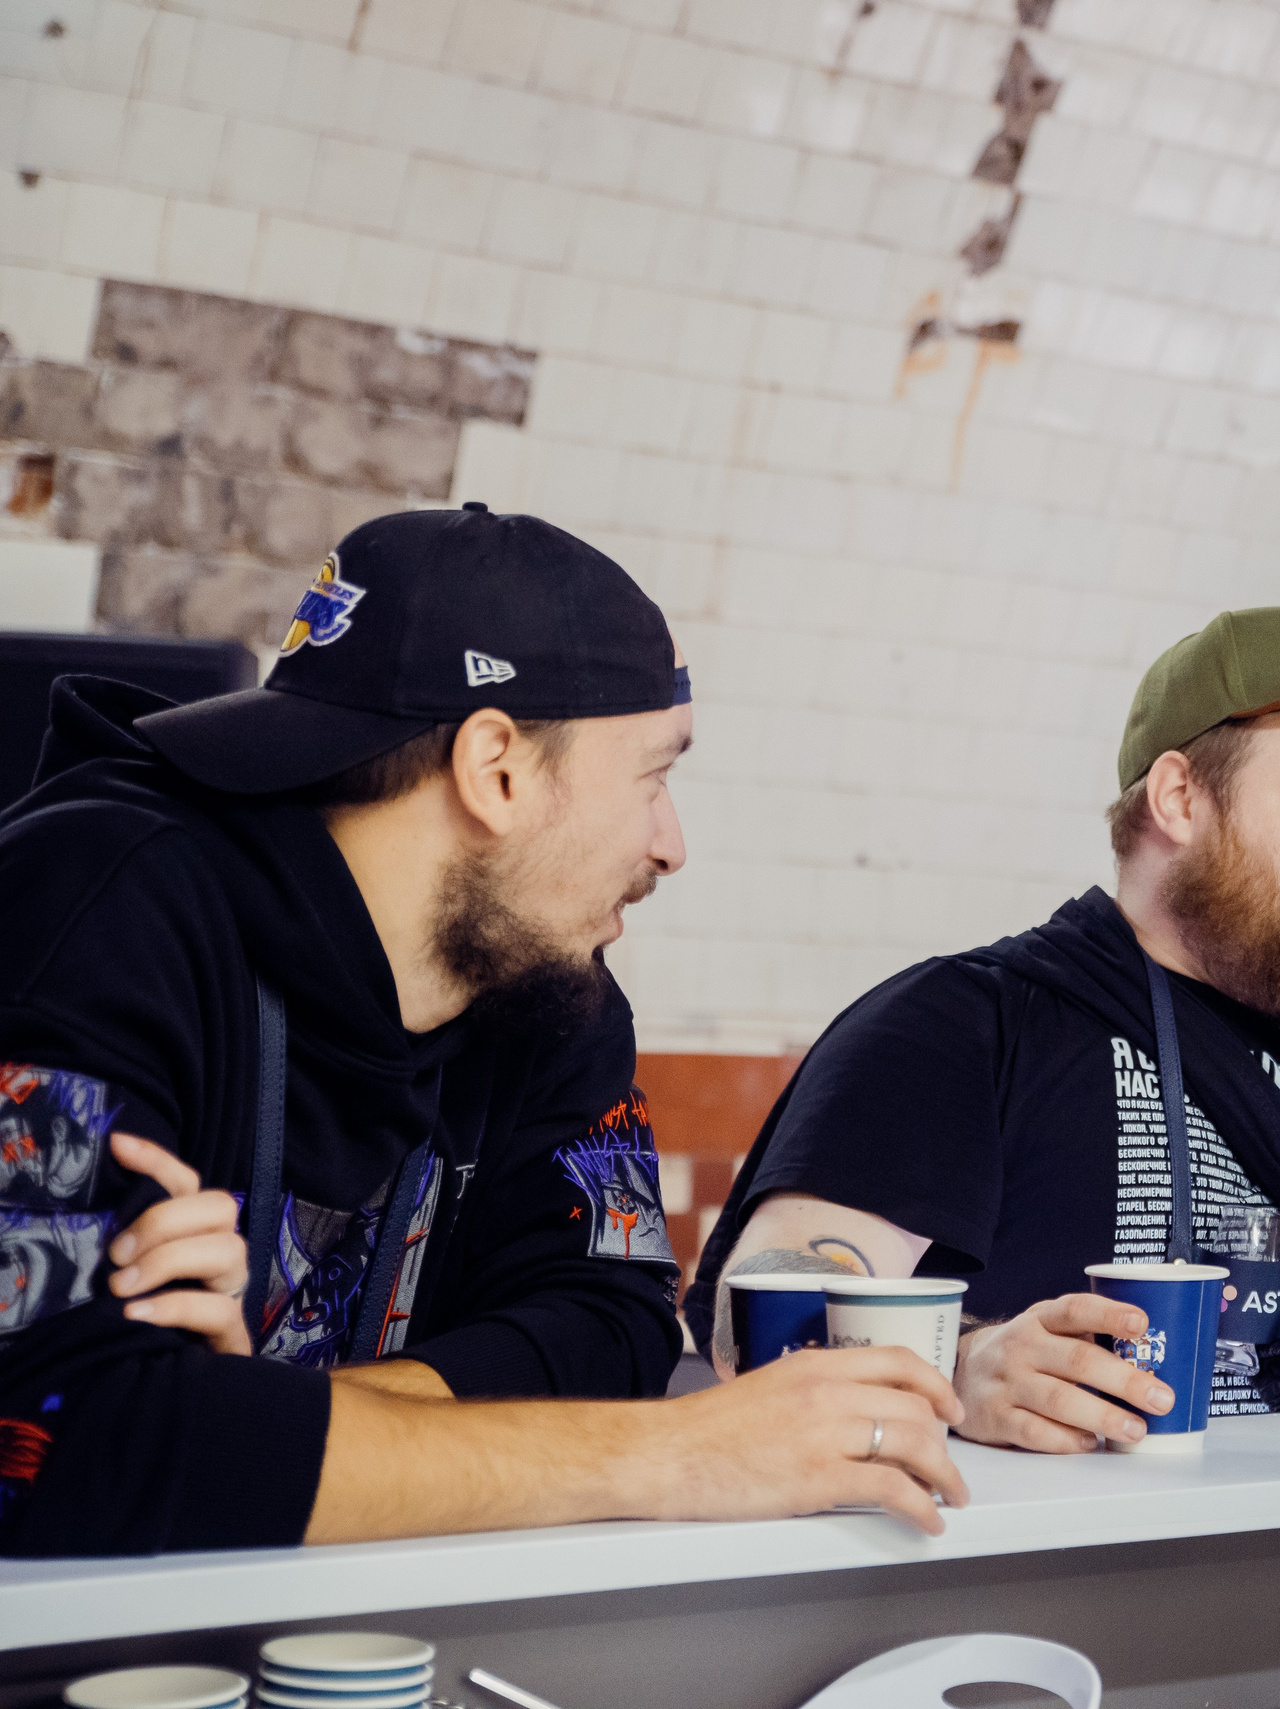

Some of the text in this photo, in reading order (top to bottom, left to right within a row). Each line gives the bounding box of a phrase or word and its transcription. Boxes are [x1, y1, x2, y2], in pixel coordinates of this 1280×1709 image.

[1111, 1037, 1134, 1069] Я
[1115, 1071, 1160, 1099] НАС
[1116, 1099, 1130, 1109] ЧТО
[1131, 1099, 1136, 1109] Я
[1137, 1100, 1150, 1110] КАК
[1117, 1111, 1140, 1121] ТАКИХ
[1141, 1112, 1152, 1121] ЖЕ
[1118, 1135, 1156, 1146] ВЕЛИКОГО
[1118, 1148, 1165, 1160] БЕСКОНЕЧНО
[1200, 1152, 1217, 1165] КУДА
[1118, 1160, 1167, 1172] БЕСКОНЕЧНОЕ
[1118, 1172, 1137, 1185] ТВОЁ
[1196, 1177, 1208, 1188] ЭТО
[1198, 1190, 1208, 1201] ПО
[1116, 1201, 1147, 1213] СТАРЕЦ,
[1116, 1215, 1168, 1226] ЗАРОЖДЕНИЯ,
[1115, 1229, 1167, 1240] ГАЗОПЫЛЕВОЕ
[1114, 1242, 1166, 1254] ФОРМИРОВАТЬ
[1227, 1376, 1233, 1387] И
[1233, 1376, 1245, 1387] ВСЕ
[1214, 1389, 1252, 1402] ПРЕДЛОЖУ
[1211, 1404, 1240, 1417] ВЕЧНОЕ,
